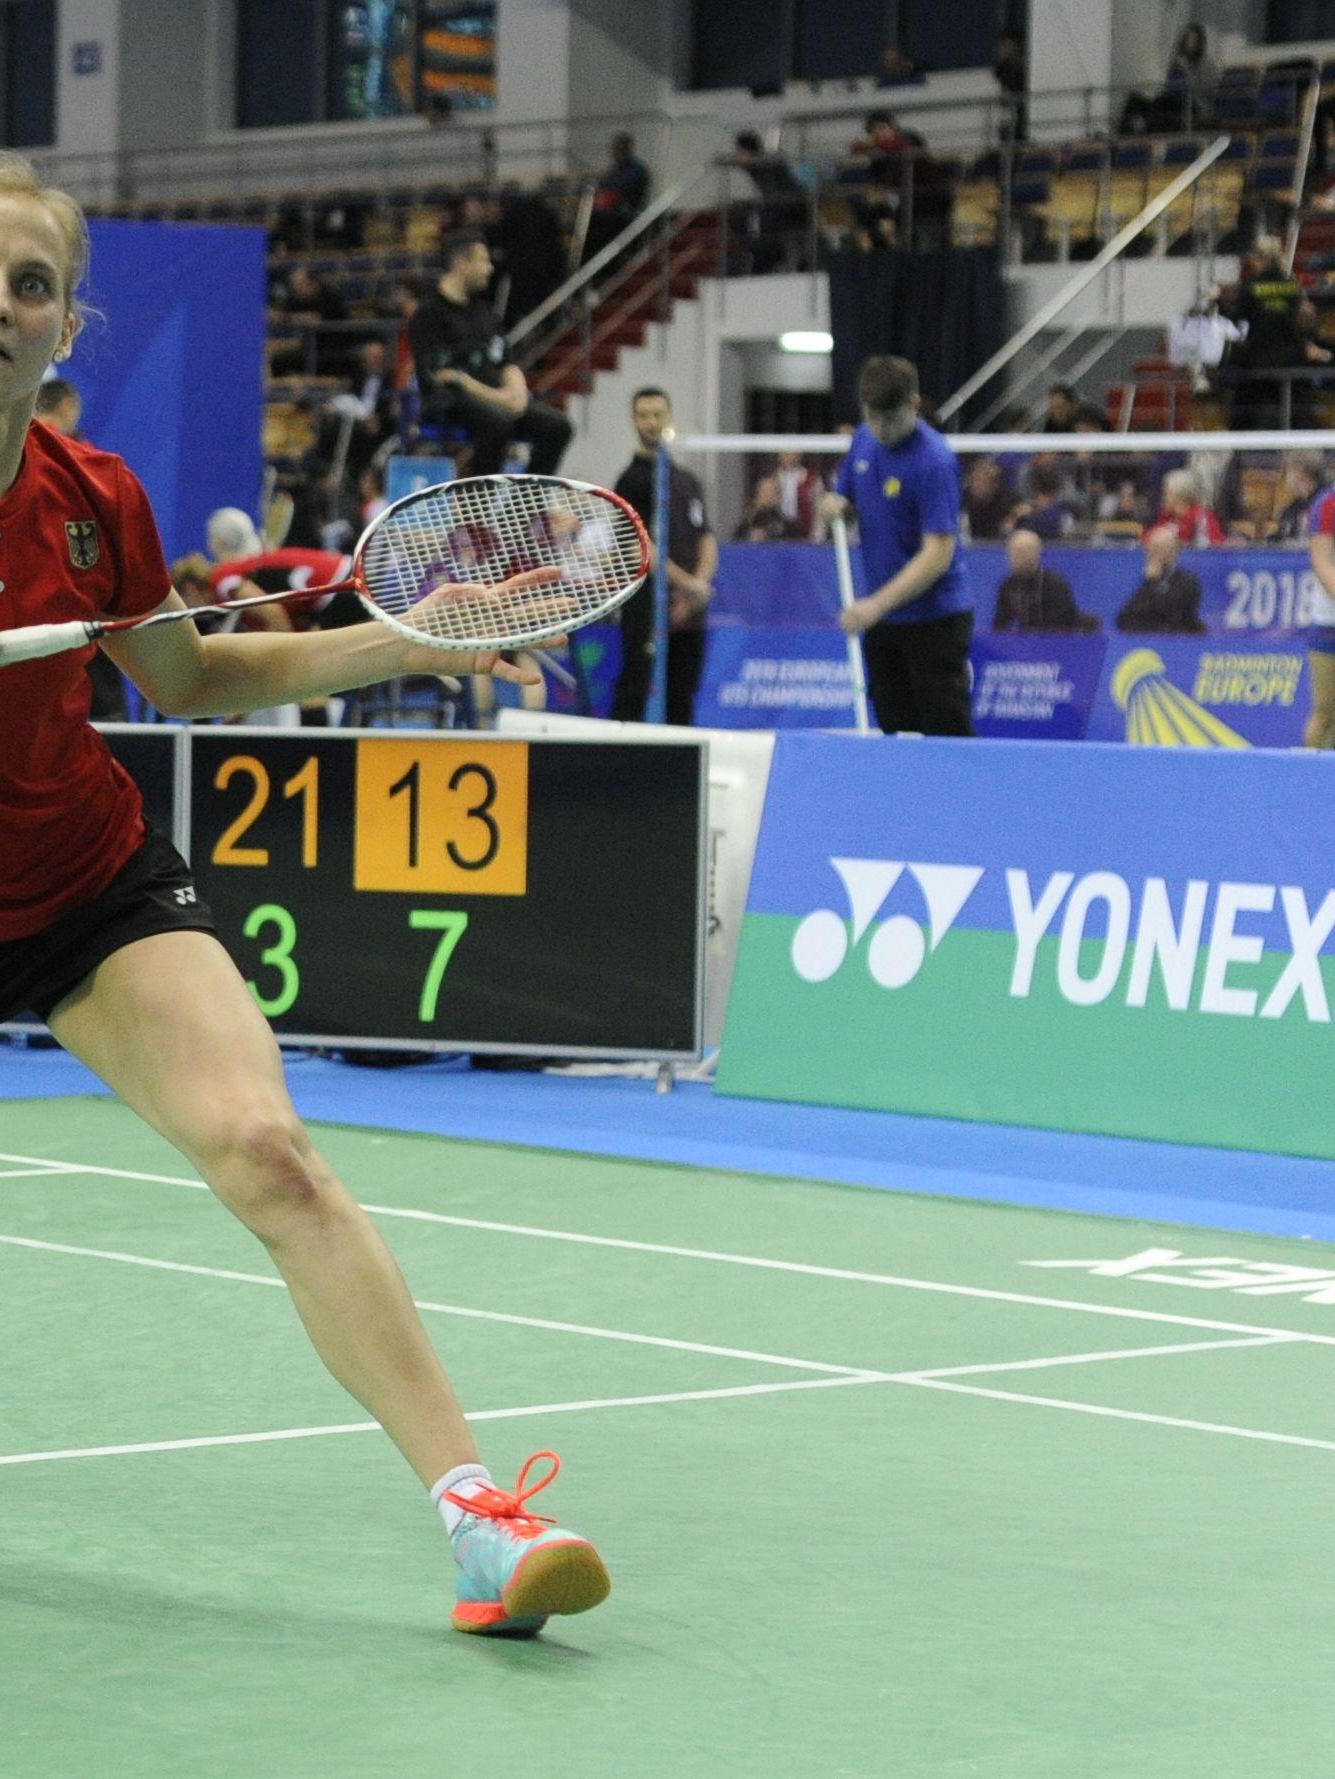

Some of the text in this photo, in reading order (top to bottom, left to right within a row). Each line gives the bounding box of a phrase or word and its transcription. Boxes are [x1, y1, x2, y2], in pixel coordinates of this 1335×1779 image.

[1195, 673, 1297, 706] EUROPE
[211, 755, 500, 871] 21 13
[242, 904, 468, 1022] 3 7
[1004, 866, 1335, 1024] YONEX
